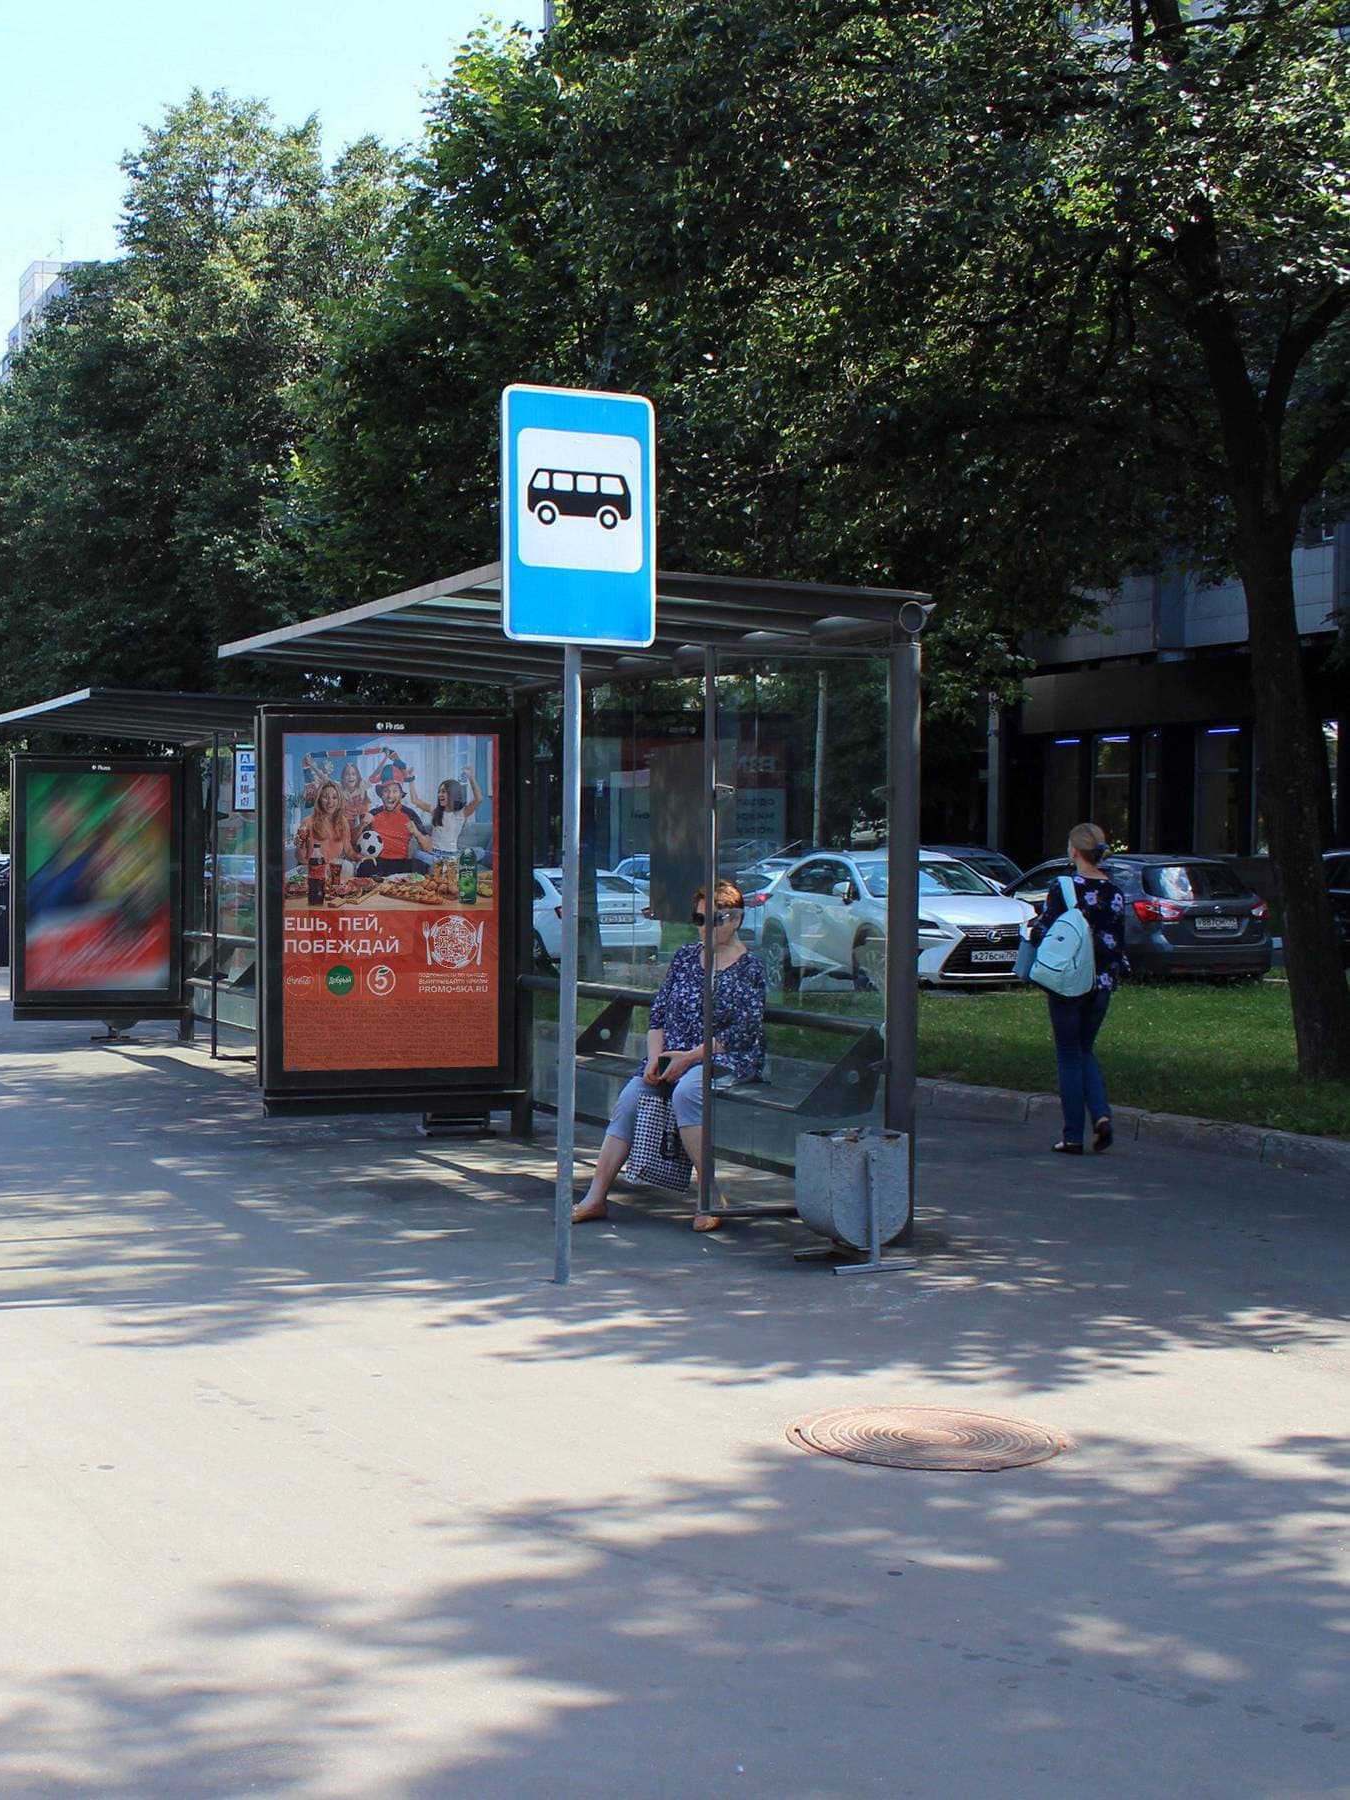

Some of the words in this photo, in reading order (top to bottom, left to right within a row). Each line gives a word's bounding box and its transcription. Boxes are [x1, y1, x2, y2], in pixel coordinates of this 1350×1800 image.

[284, 916, 332, 933] ЕШЬ,
[338, 913, 383, 934] ПЕЙ,
[284, 935, 400, 956] ПОБЕЖДАЙ
[328, 974, 353, 985] Добрый
